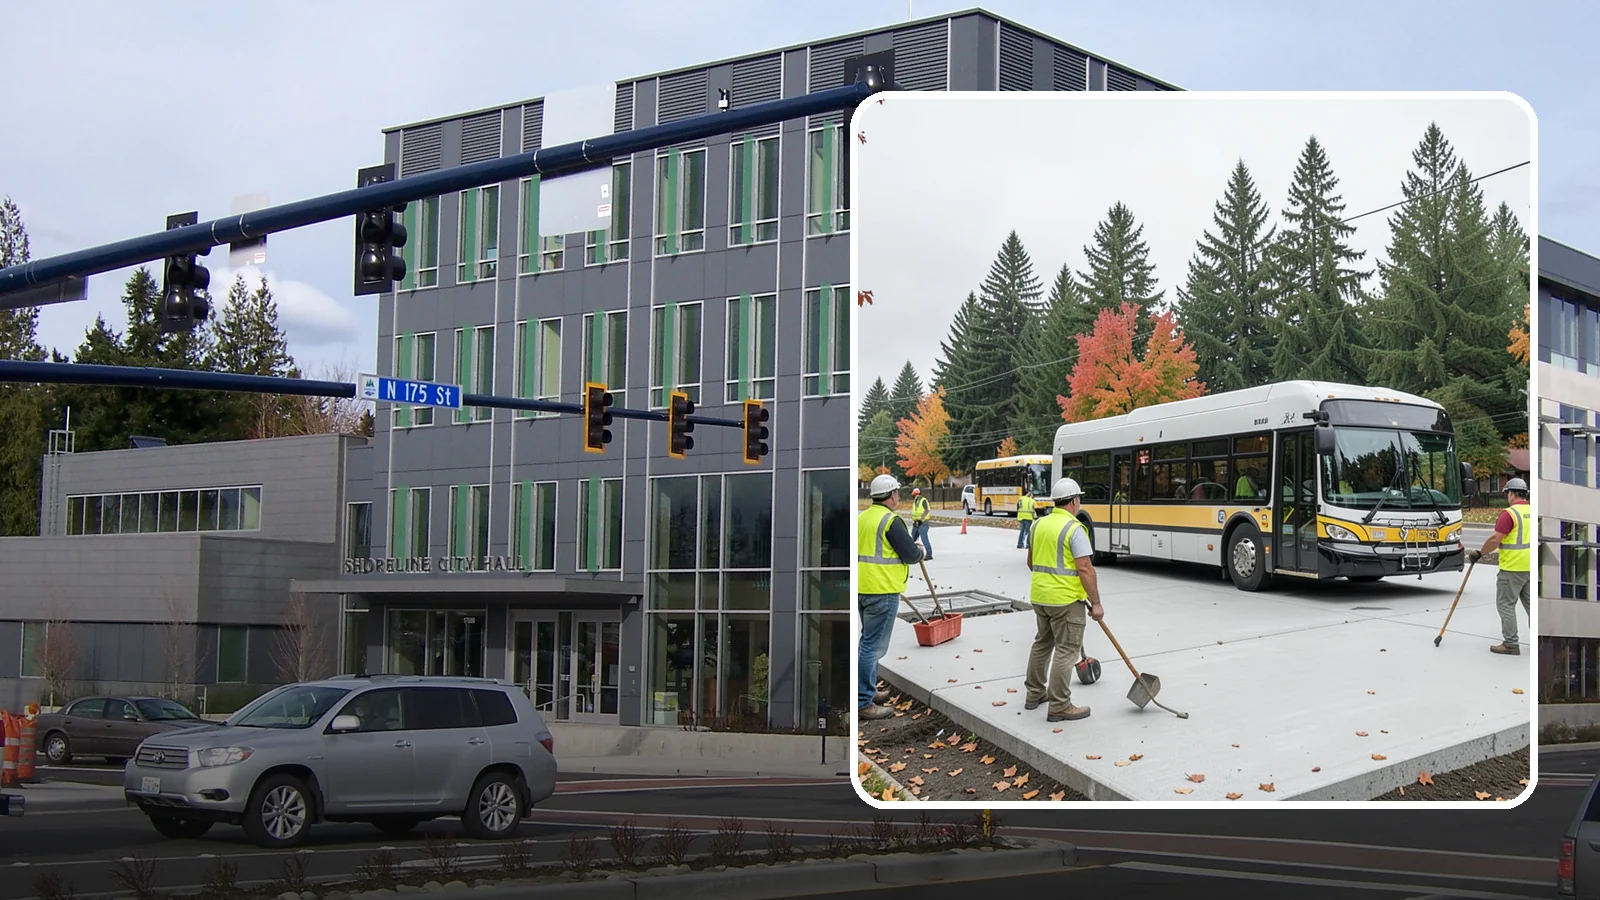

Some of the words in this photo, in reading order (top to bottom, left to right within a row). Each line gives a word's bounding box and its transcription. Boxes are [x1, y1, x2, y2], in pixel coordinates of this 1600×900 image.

[387, 380, 396, 400] N
[405, 382, 427, 403] 175
[436, 386, 452, 406] St
[344, 556, 432, 574] SHORELINE
[438, 556, 475, 573] CITY
[484, 555, 526, 572] HALL
